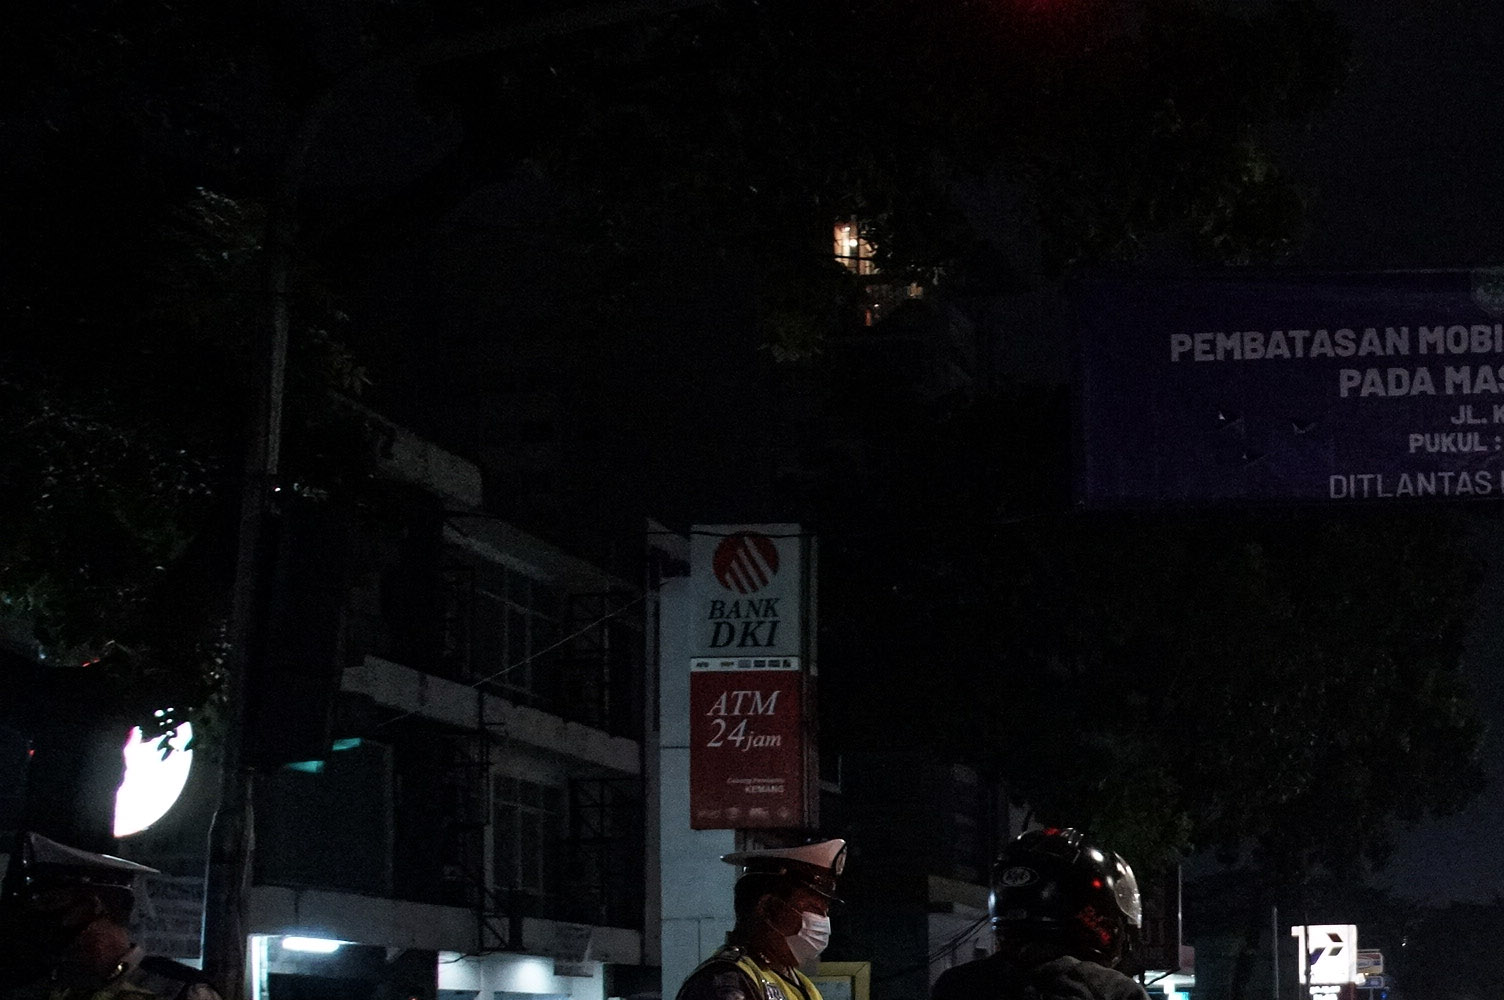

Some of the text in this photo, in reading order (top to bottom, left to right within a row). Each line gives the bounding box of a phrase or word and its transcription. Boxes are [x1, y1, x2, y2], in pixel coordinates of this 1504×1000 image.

[1170, 326, 1411, 362] PEMBATASAN
[1339, 366, 1436, 398] PADA
[1450, 404, 1488, 425] JL.
[1409, 432, 1488, 454] PUKUL
[1329, 470, 1493, 499] DITLANTAS
[708, 598, 780, 620] BANK
[708, 620, 780, 648] DKI
[706, 690, 782, 716] ATM
